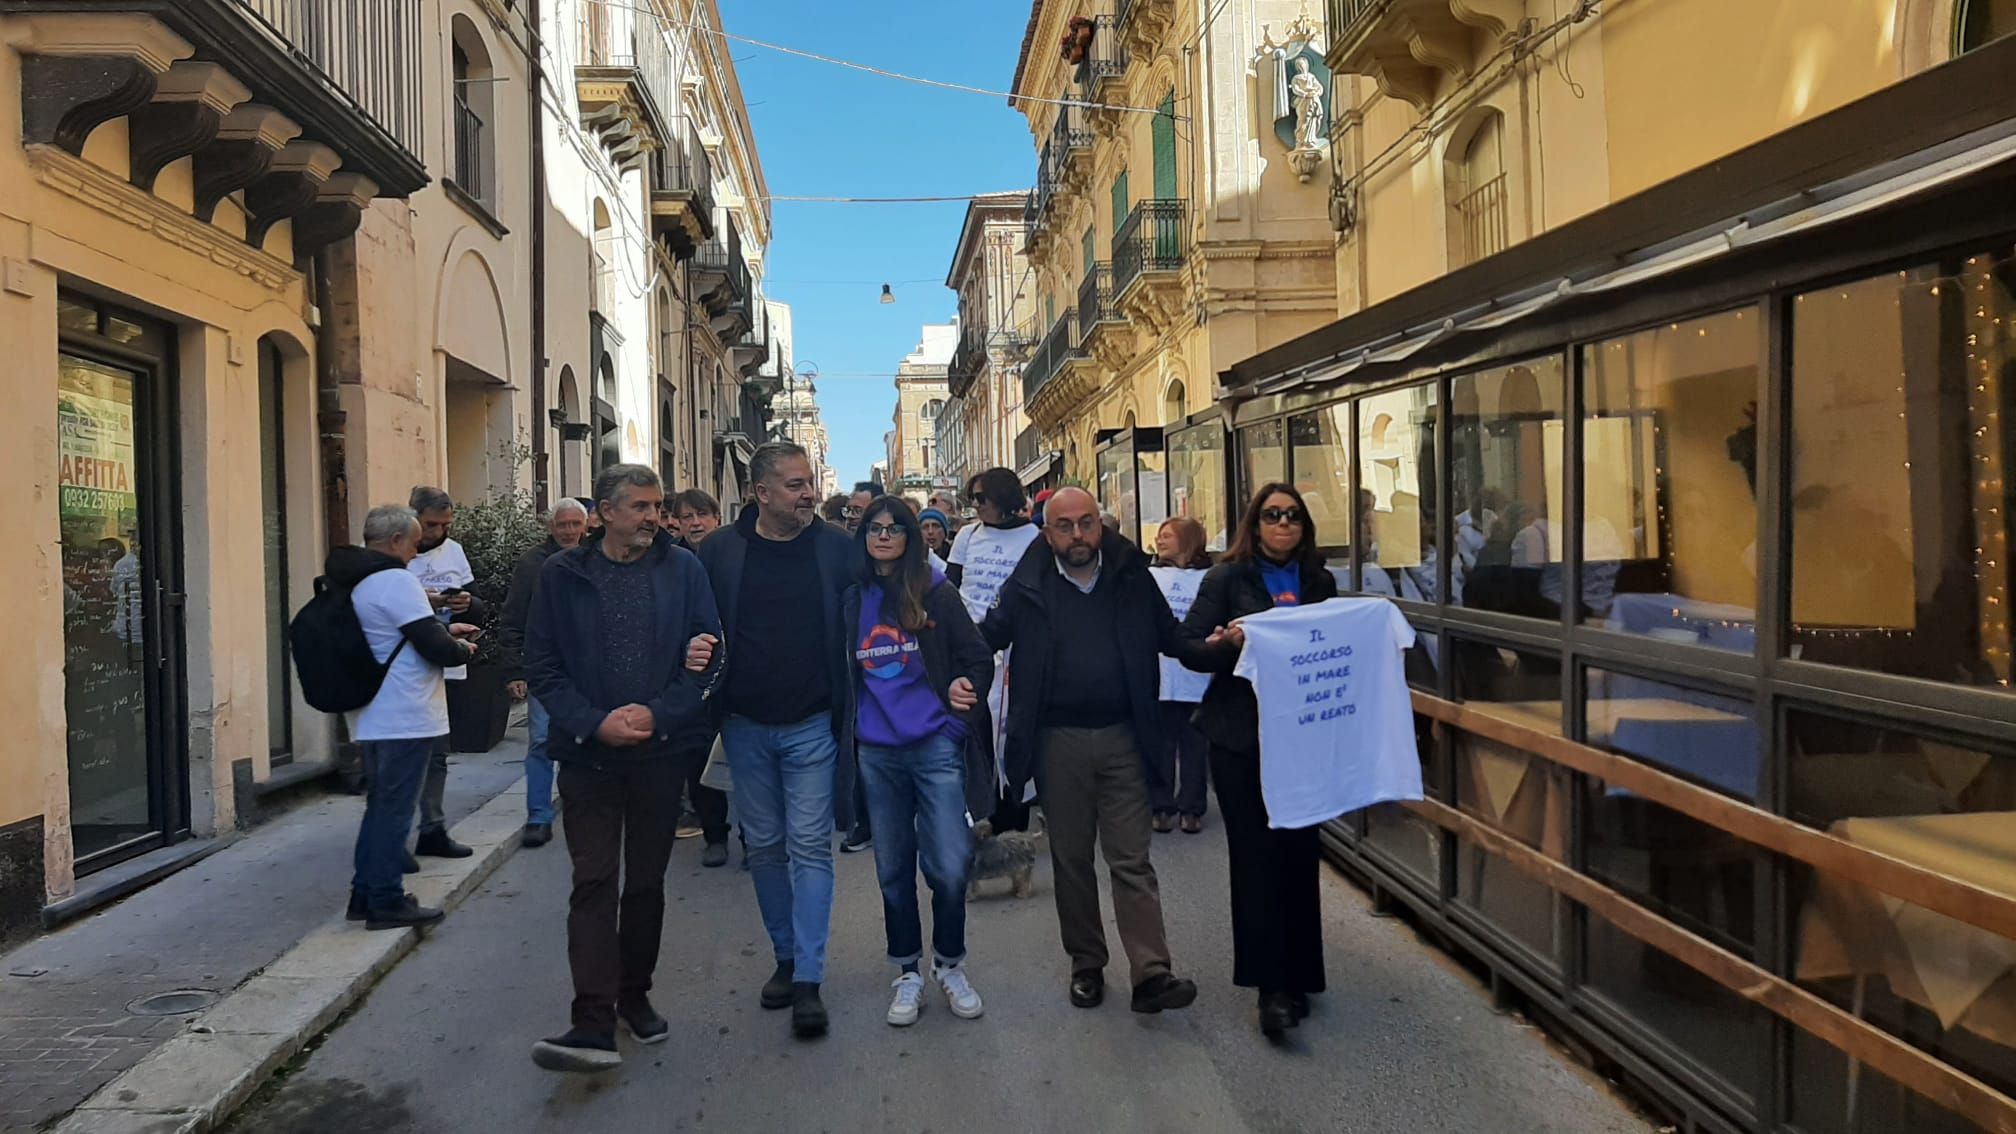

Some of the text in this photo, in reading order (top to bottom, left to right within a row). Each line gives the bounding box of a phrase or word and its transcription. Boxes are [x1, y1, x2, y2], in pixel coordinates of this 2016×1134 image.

[60, 453, 128, 491] AFFITTA
[992, 545, 1004, 554] IL
[974, 556, 1017, 567] SOCCORS
[987, 570, 1009, 579] MAR
[1310, 629, 1325, 643] IL
[1290, 645, 1353, 667] SOCCORSO
[1298, 665, 1351, 685] IN MARE
[1305, 689, 1331, 703] NON
[1298, 703, 1357, 725] UN REATO
